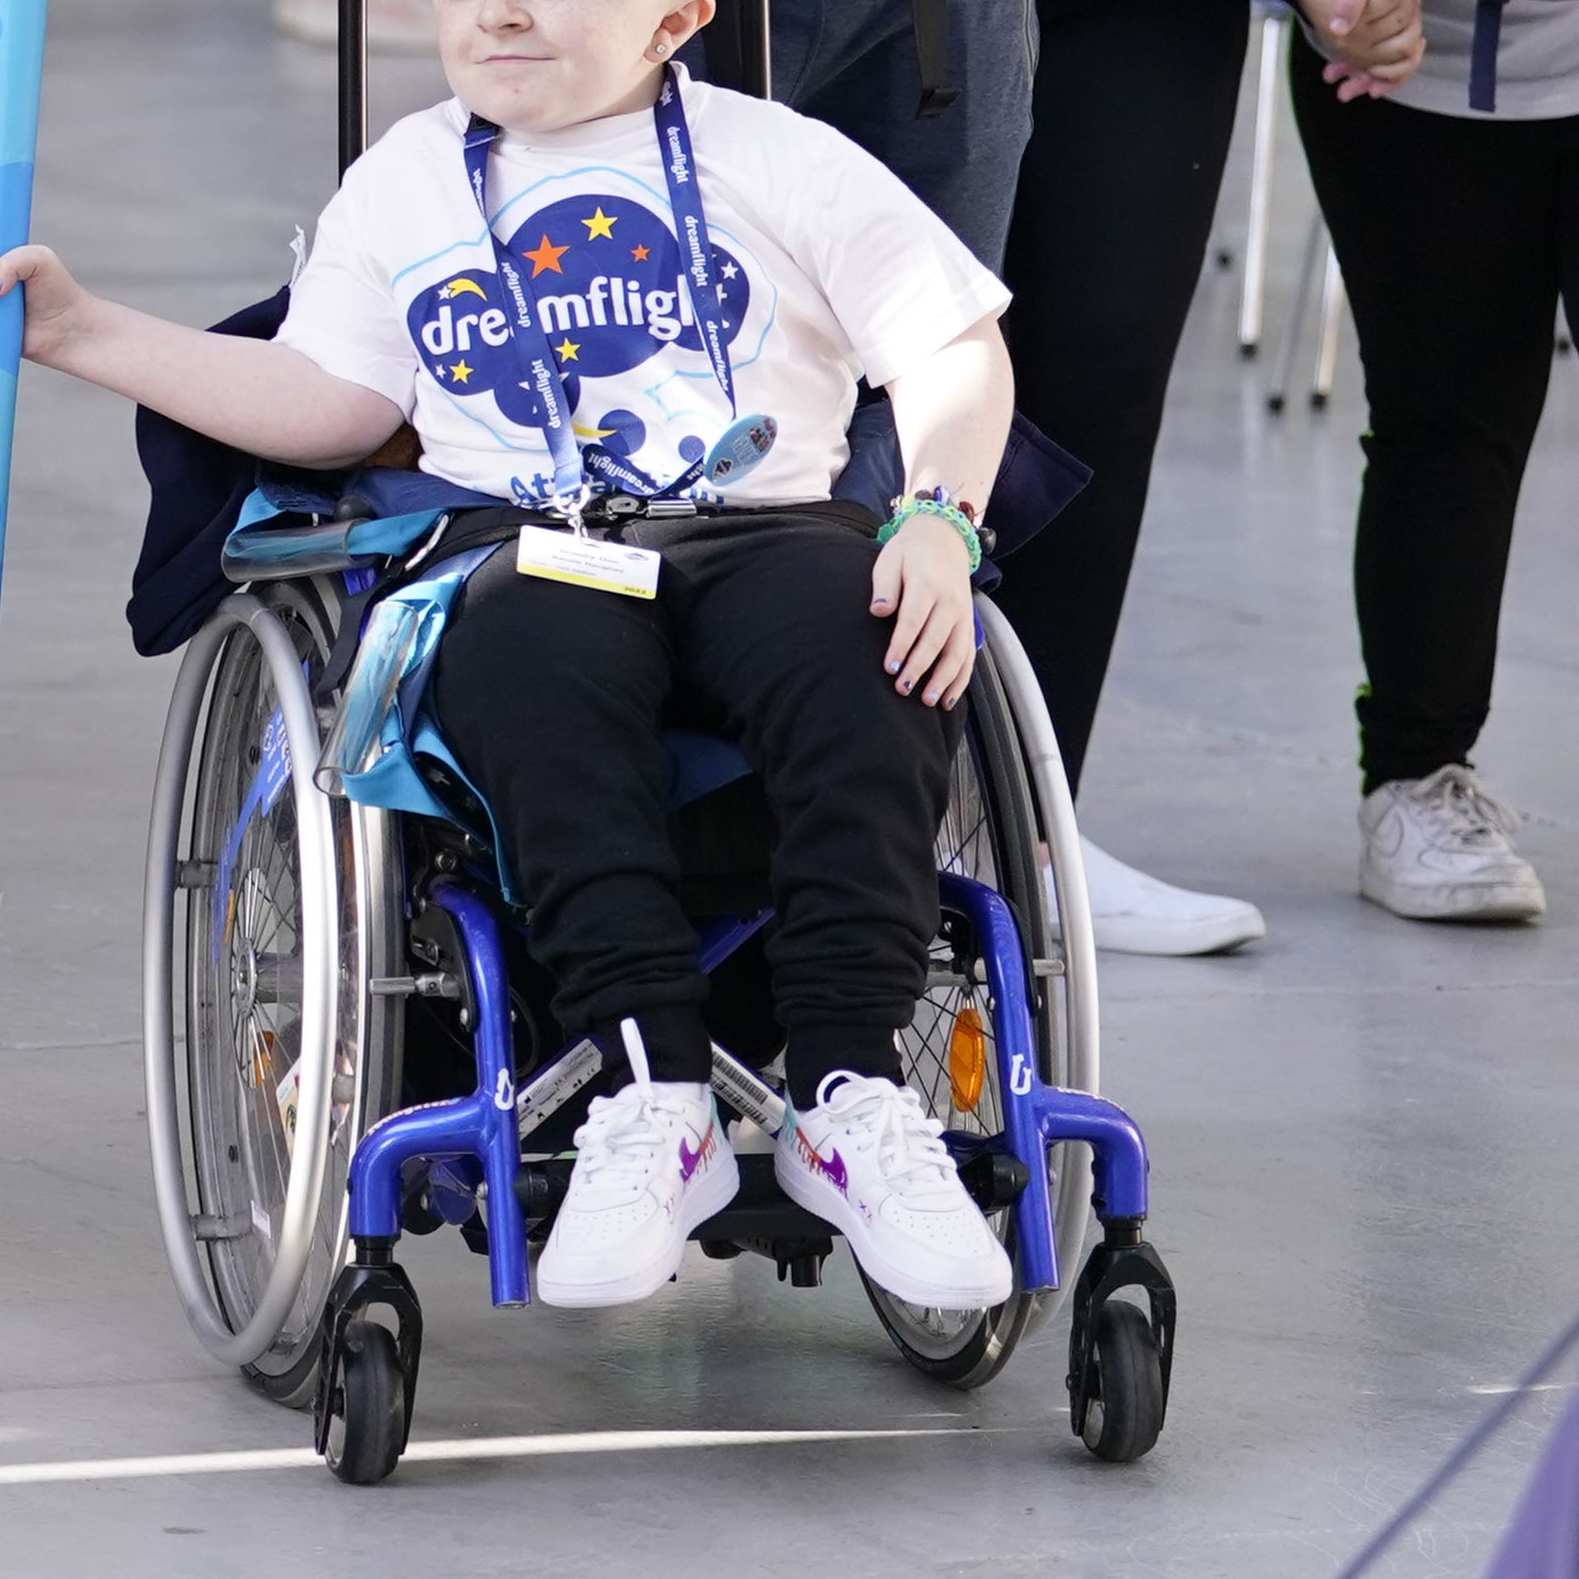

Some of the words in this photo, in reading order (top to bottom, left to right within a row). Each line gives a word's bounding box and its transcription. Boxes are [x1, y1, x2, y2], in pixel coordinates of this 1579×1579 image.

[666, 125, 689, 184] dreamflight
[685, 215, 708, 288] dreamflight
[501, 261, 531, 329] dreamflight
[531, 359, 562, 430] dreamflight
